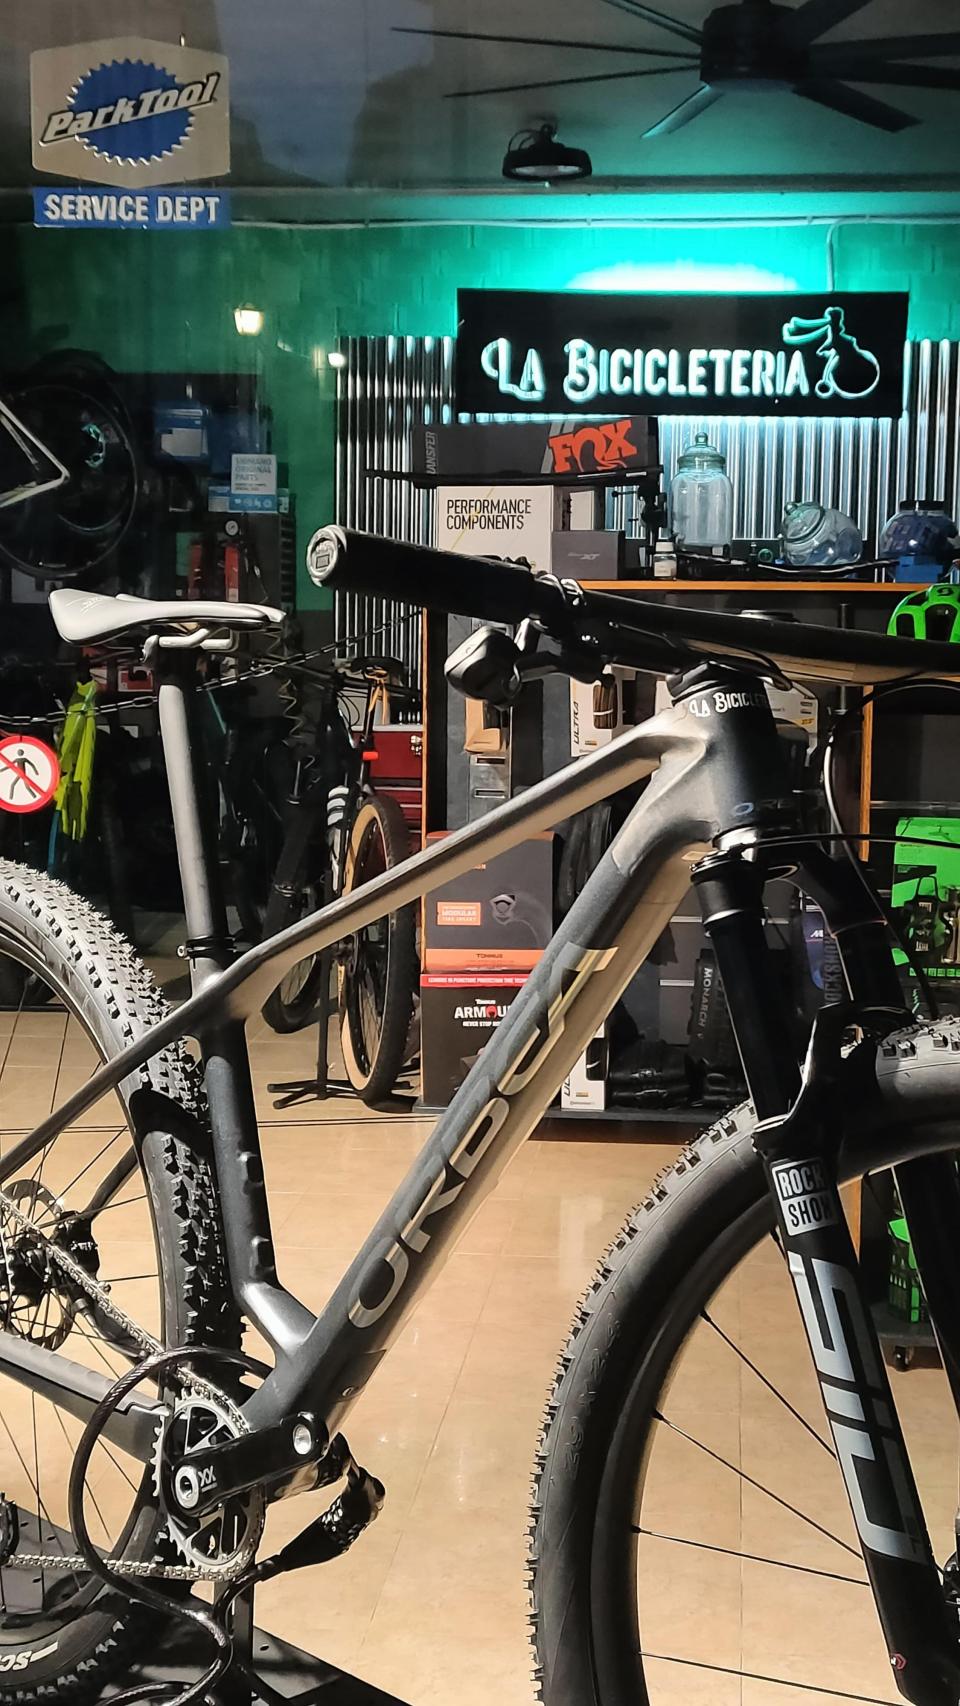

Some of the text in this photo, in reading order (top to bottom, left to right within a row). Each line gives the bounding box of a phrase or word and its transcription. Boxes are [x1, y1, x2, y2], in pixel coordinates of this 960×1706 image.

[45, 194, 220, 223] SERVICE DEPT
[563, 338, 810, 402] BICICLETERIA
[549, 419, 637, 474] FOX
[446, 515, 525, 530] COMPONENTS
[447, 499, 532, 514] PERFORMANCE
[454, 1005, 511, 1019] ARMOU
[698, 967, 713, 1028] MONARCH
[346, 940, 619, 1327] ORBEA
[777, 1163, 827, 1198] ROCK
[197, 1465, 217, 1487] XX
